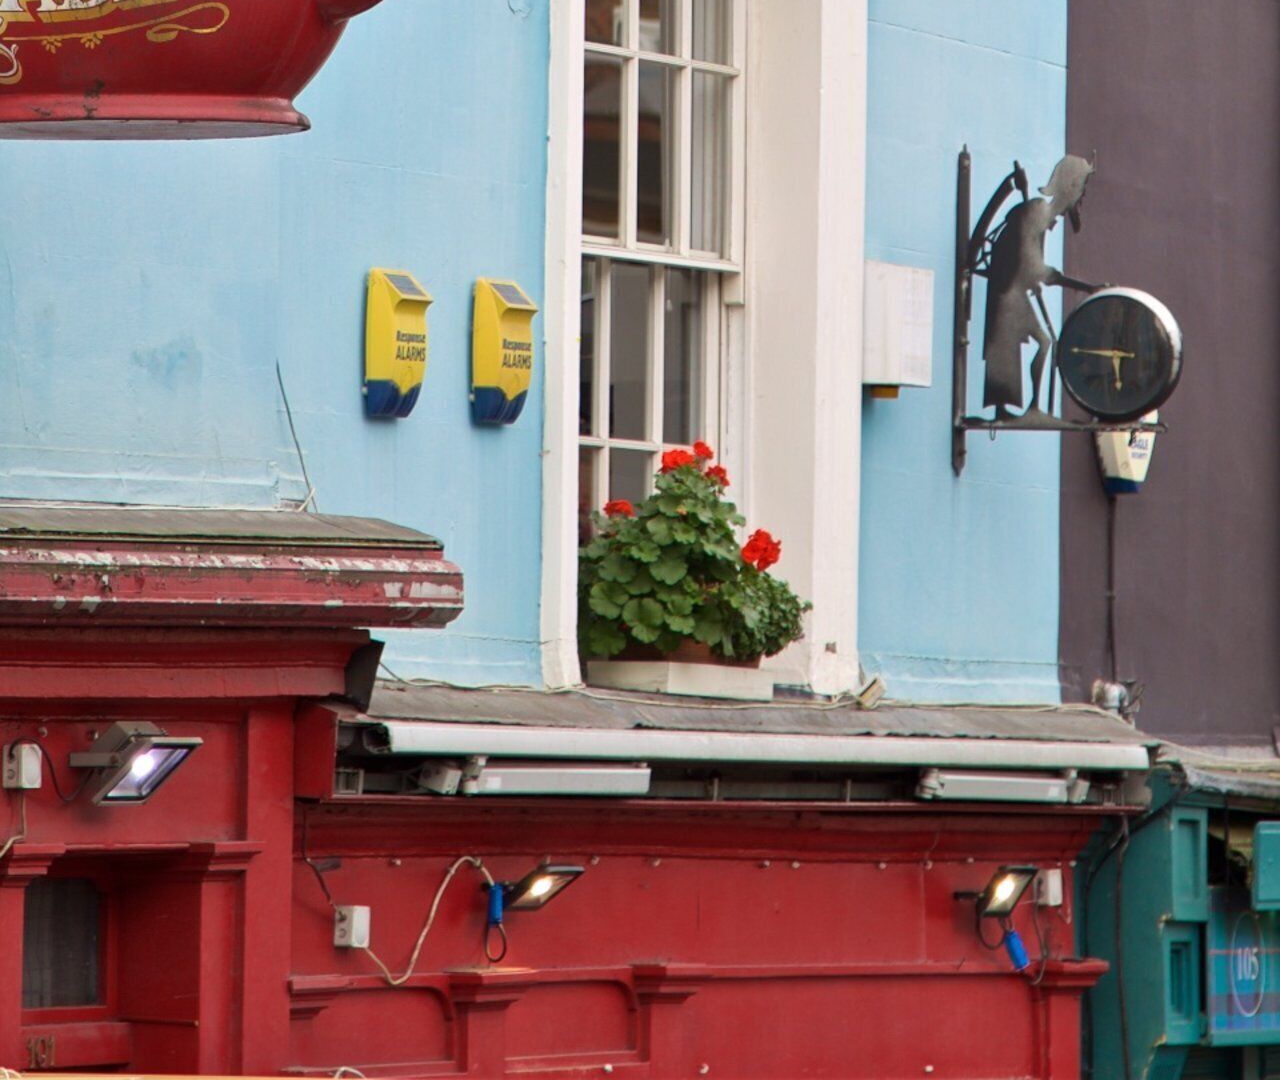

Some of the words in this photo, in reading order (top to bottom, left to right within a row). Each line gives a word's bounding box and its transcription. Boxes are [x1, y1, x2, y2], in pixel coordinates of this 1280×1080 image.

[396, 330, 426, 345] Response
[502, 338, 531, 352] Response
[395, 346, 426, 361] ALARMS
[501, 354, 532, 369] ALARMS
[1237, 947, 1259, 981] 105
